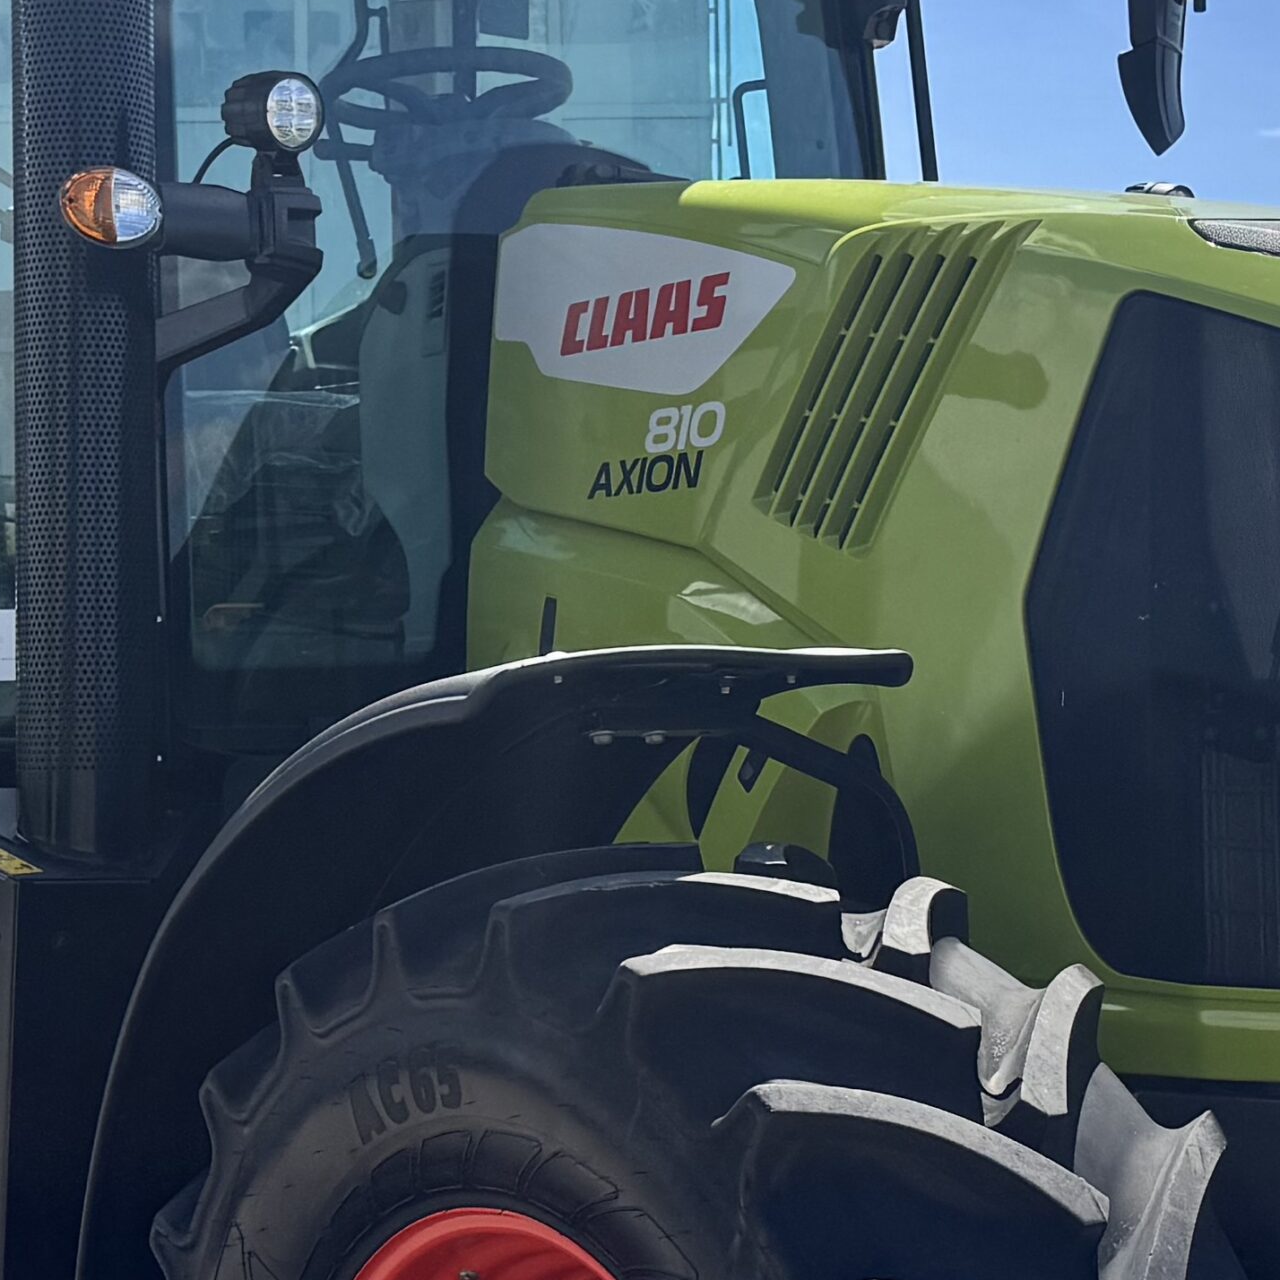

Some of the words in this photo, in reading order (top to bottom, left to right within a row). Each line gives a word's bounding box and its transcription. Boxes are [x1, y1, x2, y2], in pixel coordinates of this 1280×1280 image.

[560, 272, 730, 356] CLAAS
[644, 401, 726, 454] 810
[587, 450, 703, 500] AXION
